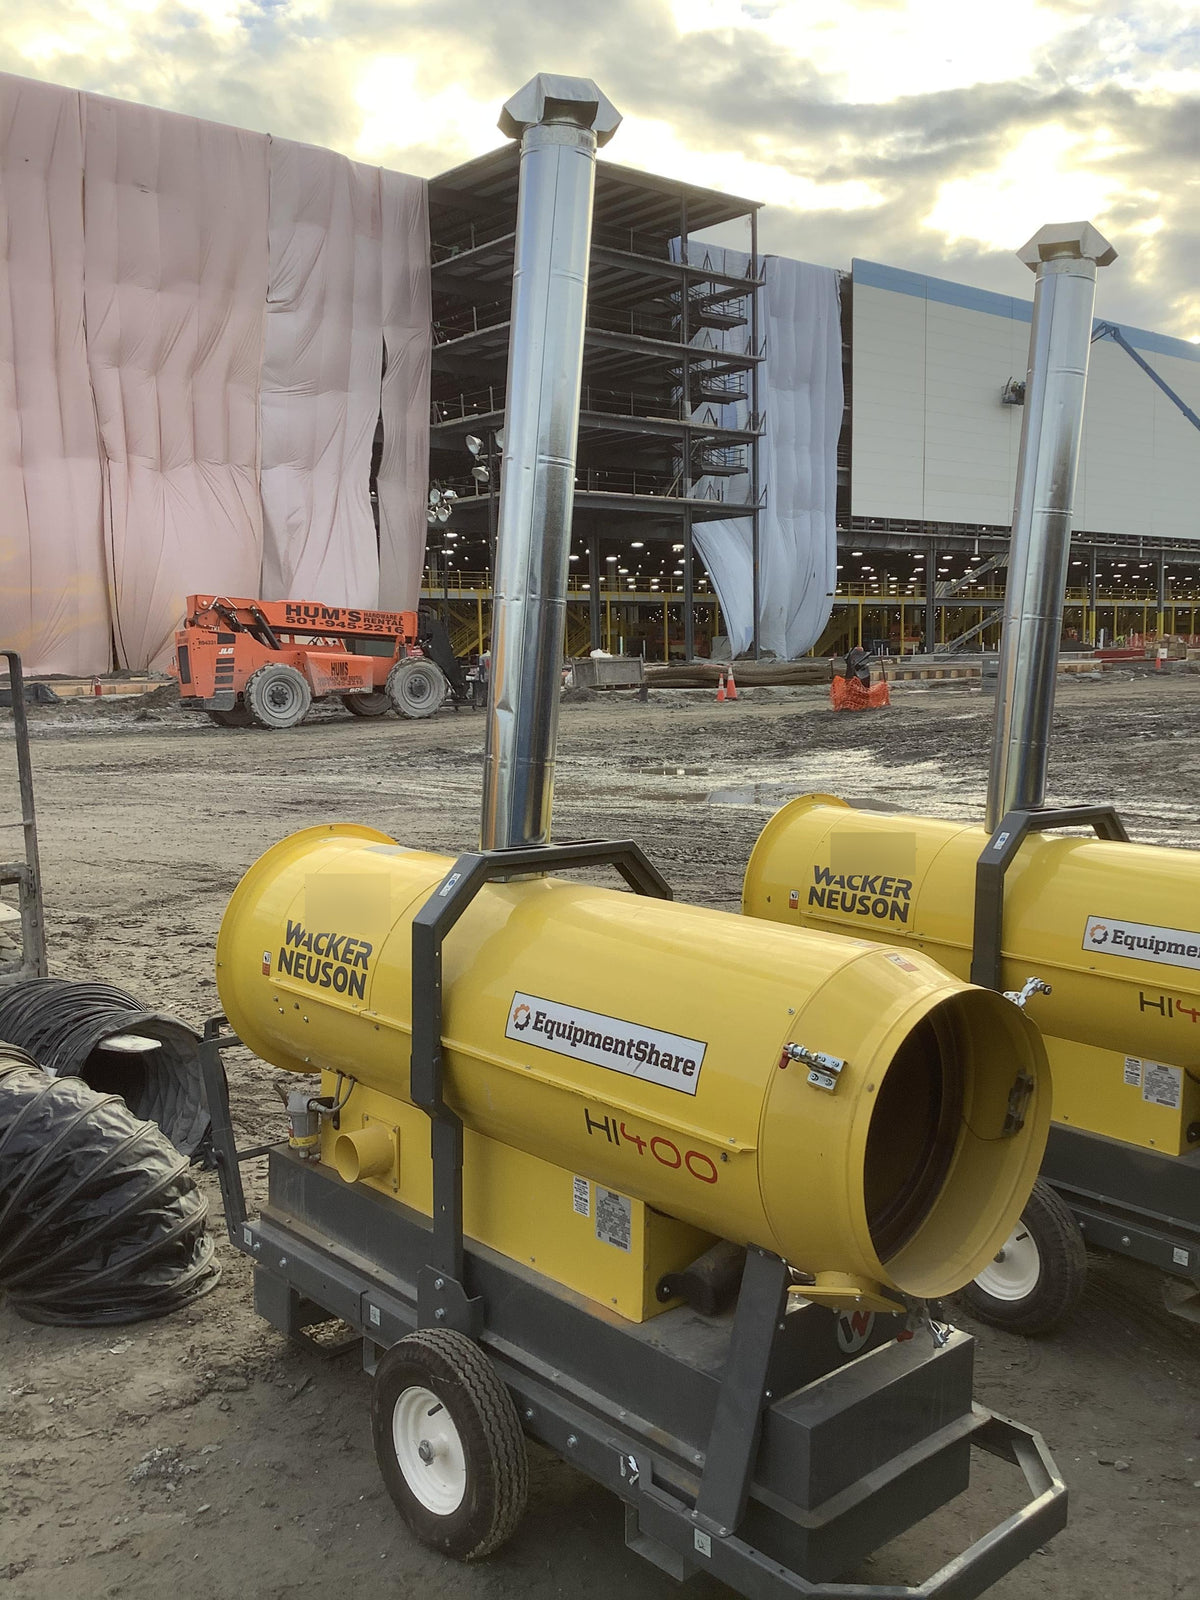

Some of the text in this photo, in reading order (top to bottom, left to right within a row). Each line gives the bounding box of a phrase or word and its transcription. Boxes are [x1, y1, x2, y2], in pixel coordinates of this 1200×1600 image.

[285, 603, 362, 623] HUM'S
[285, 616, 405, 634] 501-945-2216
[363, 612, 398, 621] HARDWARE
[363, 617, 404, 627] RENTAL
[218, 647, 235, 655] JLG
[330, 661, 349, 676] HUMS
[814, 865, 913, 900] WACKER
[808, 886, 910, 923] NEUSON
[285, 919, 373, 971] WACKER
[1110, 928, 1200, 959] Equipme
[277, 947, 367, 1001] NEUSON
[531, 1010, 697, 1078] EquipmentShare
[584, 1107, 718, 1184] HI400
